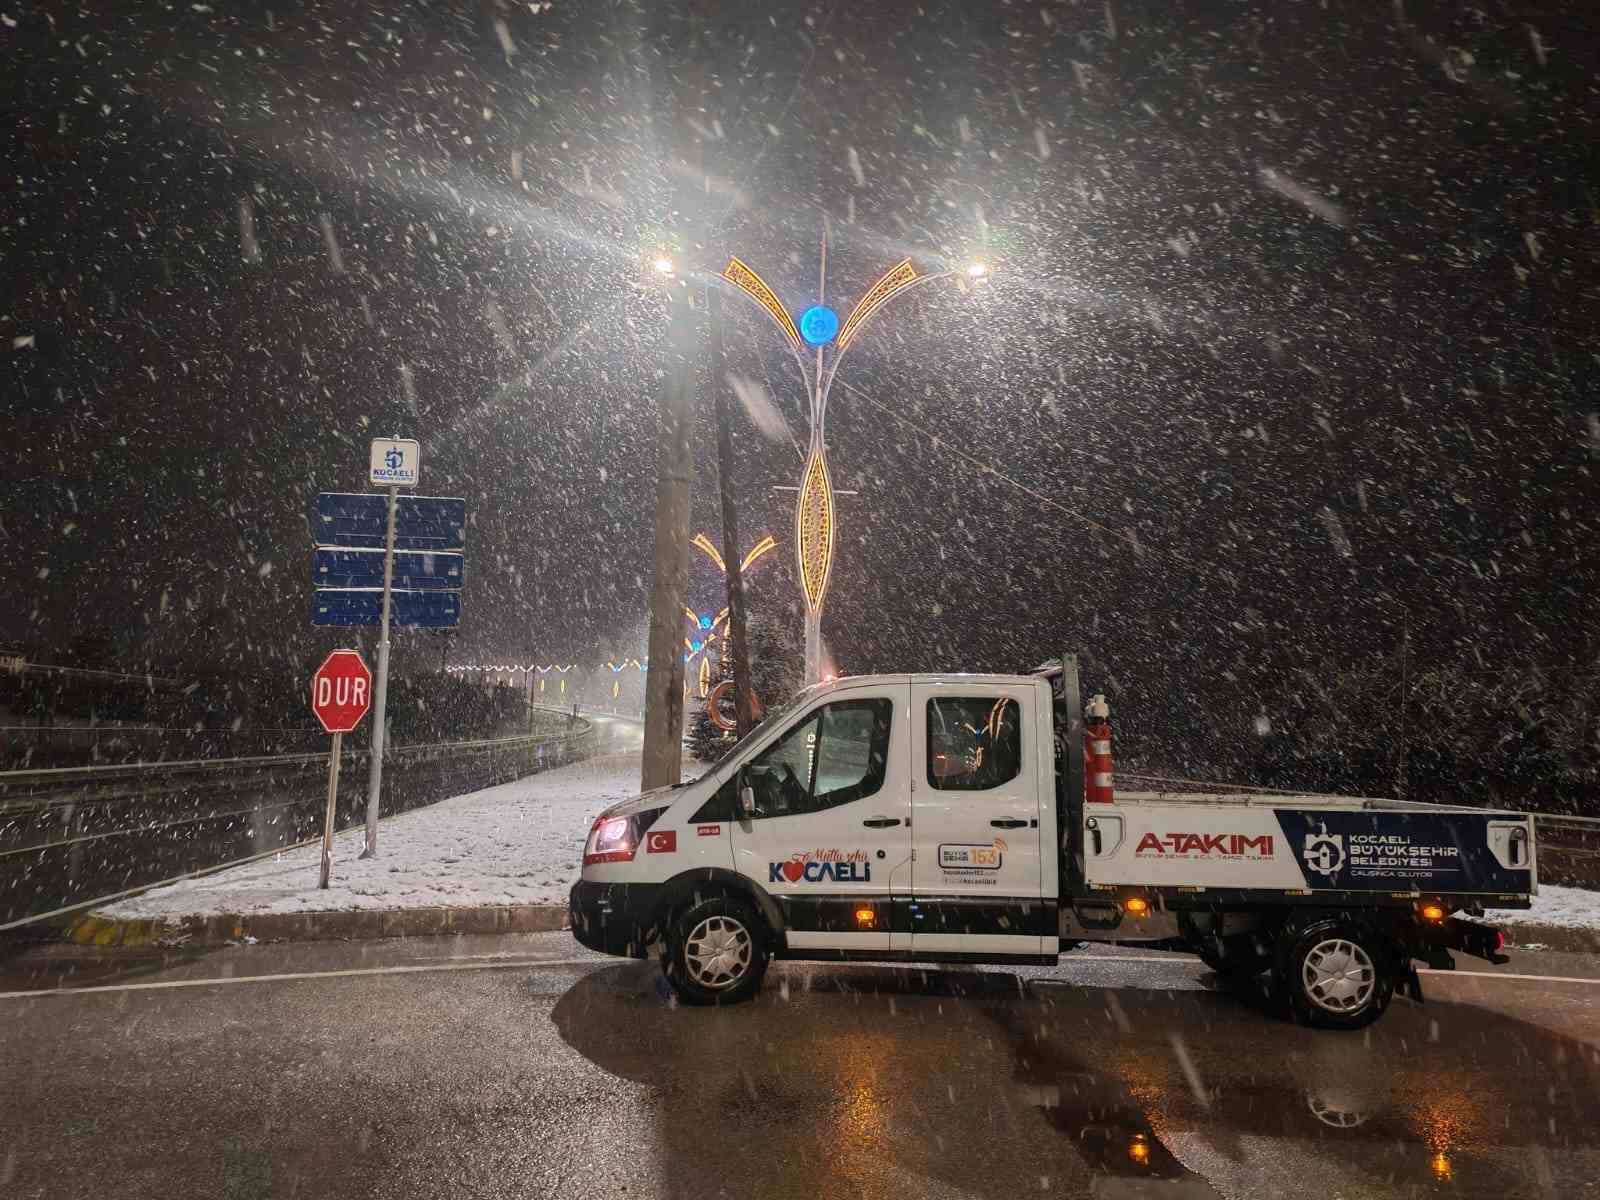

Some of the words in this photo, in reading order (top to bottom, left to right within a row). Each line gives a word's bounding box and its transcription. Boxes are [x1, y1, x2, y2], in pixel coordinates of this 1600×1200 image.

[318, 677, 367, 707] DUR
[1136, 832, 1274, 855] A-TAKIMI
[1350, 845, 1459, 857] BÜYÜKŞEHİR
[970, 848, 996, 865] 153
